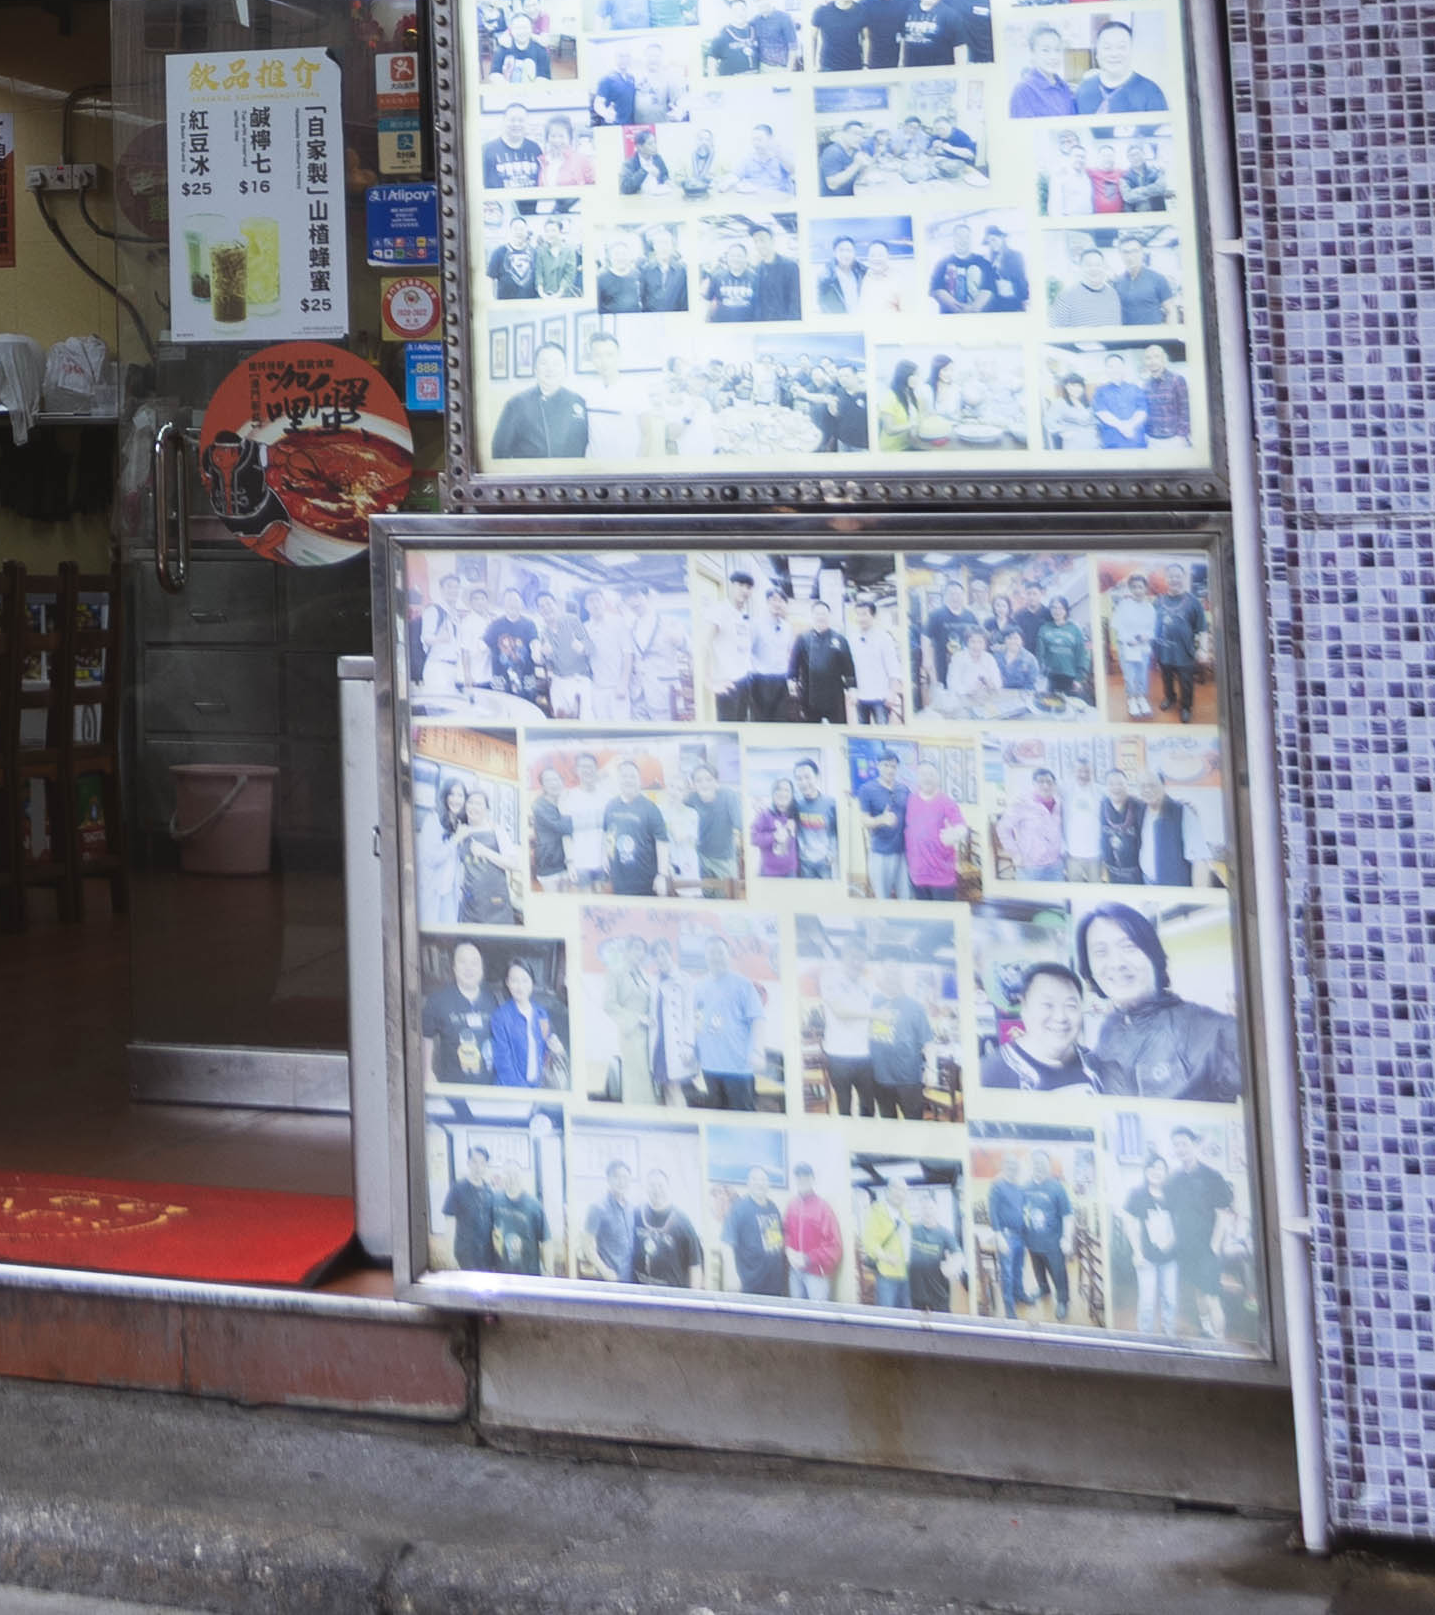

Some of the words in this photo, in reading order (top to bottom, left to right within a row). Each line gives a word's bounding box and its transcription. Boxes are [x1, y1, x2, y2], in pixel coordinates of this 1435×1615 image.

[188, 56, 322, 91] 飲品推介
[188, 110, 210, 176] 紅豆冰
[249, 106, 272, 174] 鹹檸七
[181, 182, 212, 197] $25
[239, 180, 271, 195] $16
[300, 298, 332, 313] $25
